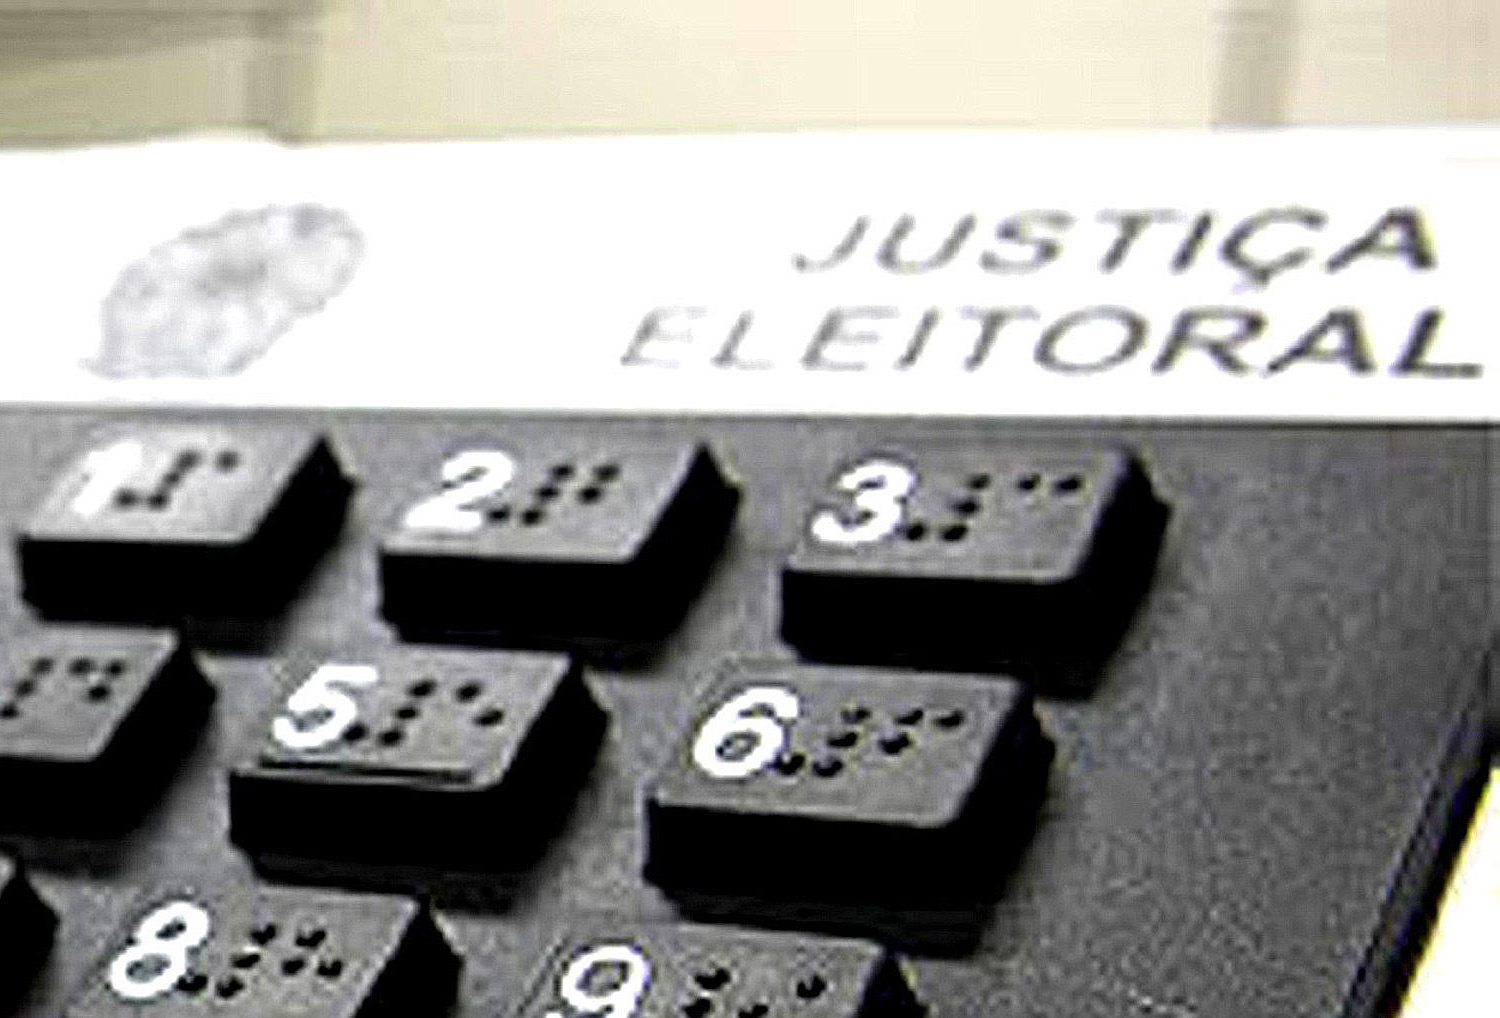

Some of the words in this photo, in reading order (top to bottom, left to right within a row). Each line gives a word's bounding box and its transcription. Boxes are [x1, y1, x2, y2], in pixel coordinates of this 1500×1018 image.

[795, 205, 1438, 293] JUSTIÇA
[620, 305, 1483, 378] ELEITORAL
[67, 442, 141, 514] 1
[405, 450, 514, 531] 2
[811, 460, 912, 542] 3
[273, 664, 378, 748] 5
[694, 686, 798, 778] 6
[110, 902, 209, 997] 8
